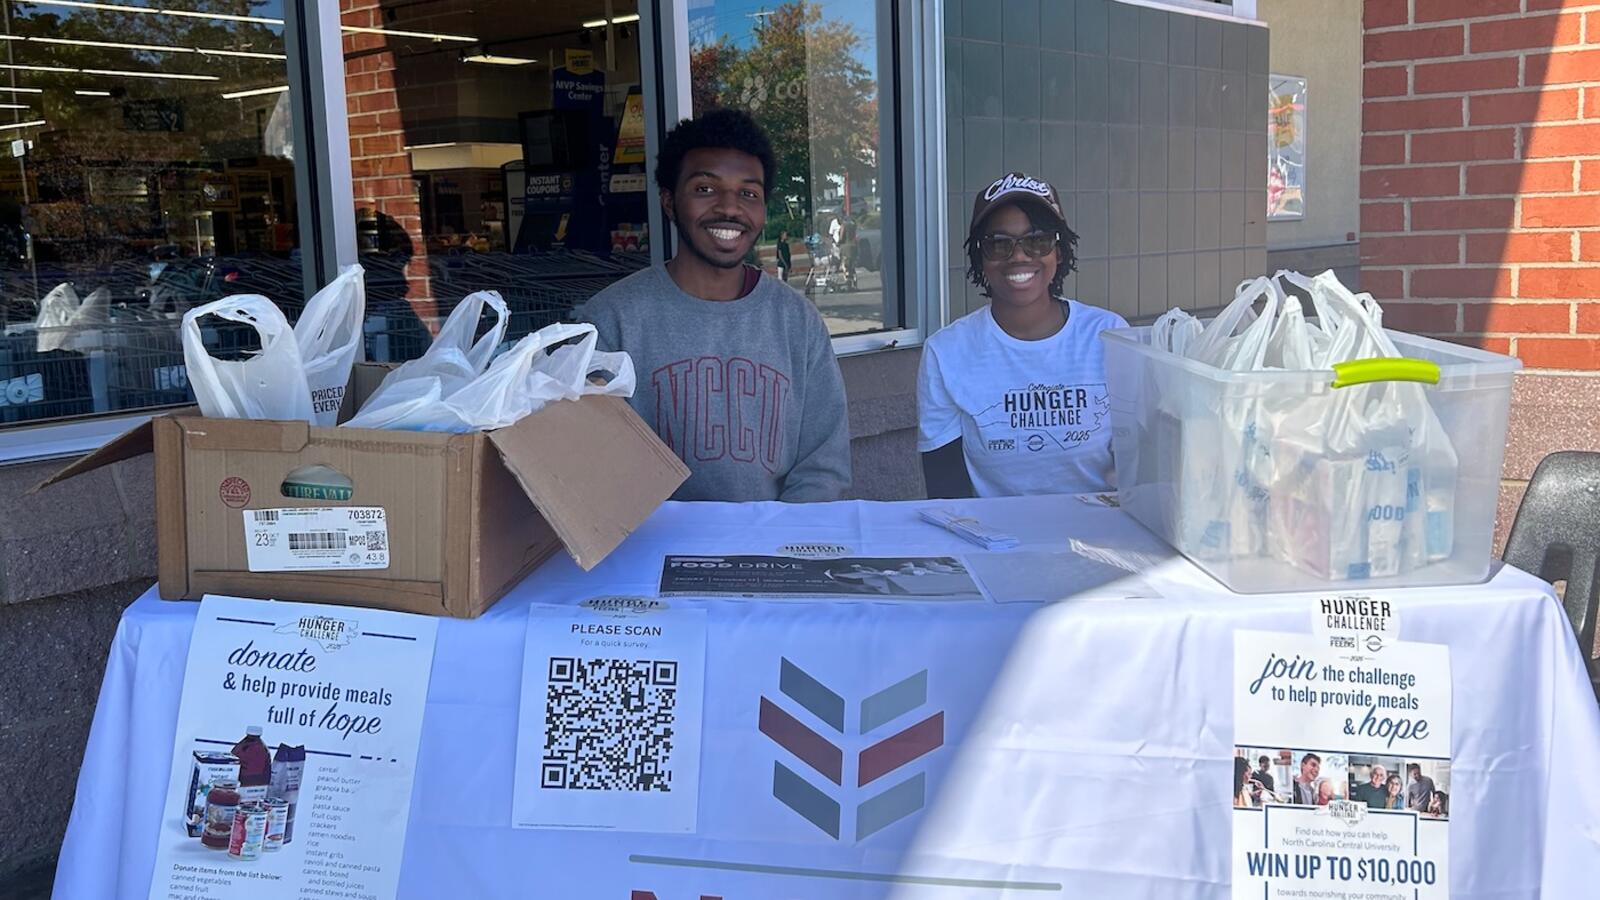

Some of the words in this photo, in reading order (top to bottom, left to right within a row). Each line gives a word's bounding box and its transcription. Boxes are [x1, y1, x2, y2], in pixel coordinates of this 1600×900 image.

[555, 79, 575, 90] MVP
[575, 81, 603, 92] Savings
[568, 91, 593, 100] Center
[529, 175, 561, 185] INSTANT
[527, 185, 561, 194] COUPONS
[1028, 383, 1065, 394] Collegiate
[1004, 388, 1088, 412] HUNGER
[652, 357, 790, 474] NCCU
[1011, 409, 1082, 429] CHALLENGE
[1064, 430, 1091, 442] 2025
[347, 510, 383, 520] 703872
[256, 533, 270, 546] 23
[739, 562, 804, 570] DRIVE
[1320, 599, 1391, 618] HUNGER
[298, 618, 345, 632] HUNGER
[1327, 615, 1386, 631] CHALLENGE
[300, 630, 340, 641] CHALLENGE
[571, 624, 621, 635] PLEASE
[624, 625, 662, 636] SCAN
[228, 640, 316, 673] donate
[1249, 653, 1318, 695] join
[1322, 665, 1345, 682] the
[1349, 667, 1416, 689] challenge
[223, 672, 236, 690] &
[241, 674, 276, 697] help
[280, 681, 341, 701] provide
[345, 687, 393, 706] meals
[1271, 686, 1285, 701] to
[1289, 685, 1317, 706] help
[1321, 689, 1372, 708] provide
[1378, 693, 1419, 710] meals
[267, 705, 295, 725] full
[298, 709, 316, 727] of
[318, 702, 382, 740] hope
[1343, 717, 1356, 735] &
[1358, 705, 1429, 749] hope
[318, 766, 339, 774] cereal
[317, 775, 340, 784] peanut
[315, 784, 340, 792] granola
[314, 793, 333, 802] pasta
[312, 803, 331, 811] pasta
[332, 805, 351, 813] sauce
[311, 811, 325, 819] fruit
[326, 813, 342, 822] cups
[310, 822, 337, 830] crackers
[308, 831, 330, 839] ramen
[330, 832, 356, 841] noodles
[1295, 827, 1312, 836] Find
[1325, 829, 1341, 837] how
[1343, 831, 1356, 840] you
[1357, 831, 1370, 839] can
[1372, 831, 1388, 840] help
[1282, 838, 1304, 847] North
[1305, 839, 1336, 849] Carolina
[1337, 840, 1363, 849] Central
[1364, 842, 1401, 852] University
[306, 849, 328, 857] instant
[329, 851, 344, 859] grits
[173, 863, 197, 873] Donate
[198, 866, 217, 875] items
[218, 868, 235, 877] from
[236, 870, 247, 878] the
[248, 871, 259, 879] list
[304, 859, 324, 867] ravioli
[325, 860, 337, 868] and
[338, 861, 362, 870] canned
[363, 864, 381, 873] pasta
[1247, 851, 1289, 878] WIN
[1295, 855, 1321, 880] UP
[1327, 857, 1351, 881] TO
[1357, 857, 1436, 886] $10,000
[171, 874, 196, 882] canned
[197, 877, 231, 886] vegetables
[322, 879, 345, 888] bottled
[345, 881, 365, 890] juices
[170, 883, 196, 892] canned
[195, 884, 209, 893] fruit
[300, 887, 324, 895] canned
[325, 889, 343, 897] stews
[344, 891, 357, 899] and
[358, 892, 377, 900] soups
[1277, 888, 1308, 897] towards
[1309, 890, 1346, 900] nourishing
[1348, 892, 1364, 900] your
[183, 892, 197, 900] and
